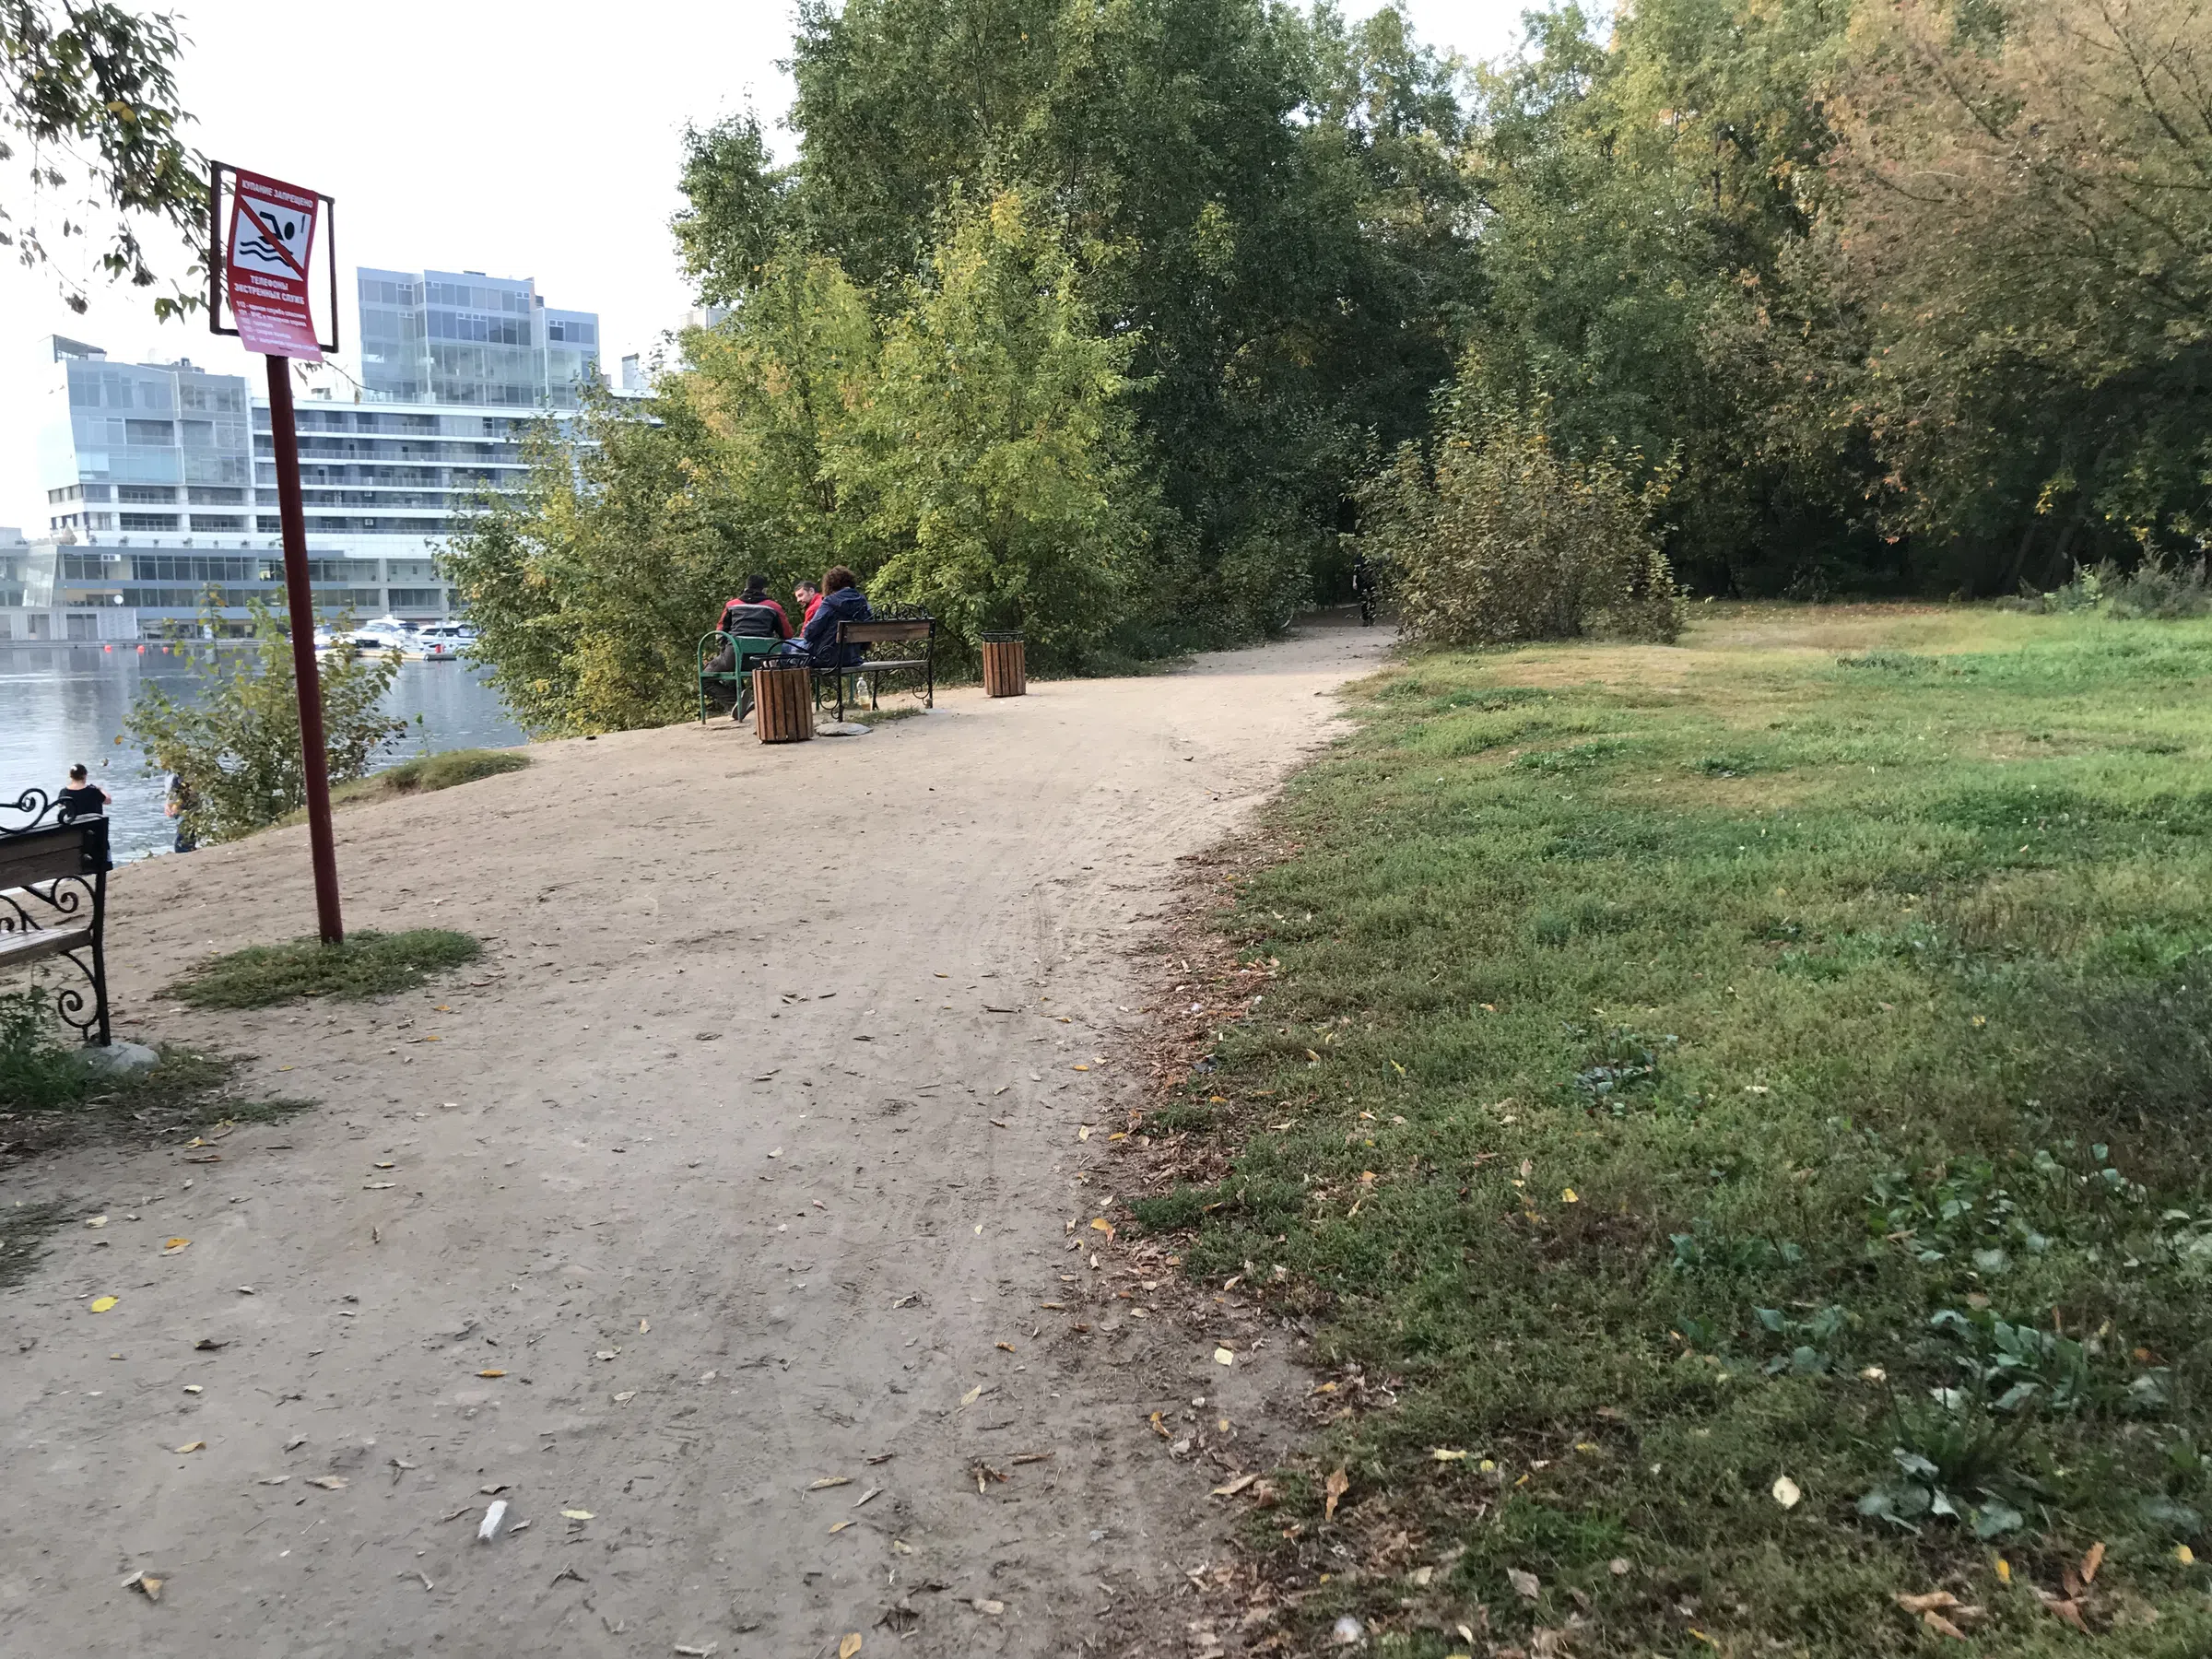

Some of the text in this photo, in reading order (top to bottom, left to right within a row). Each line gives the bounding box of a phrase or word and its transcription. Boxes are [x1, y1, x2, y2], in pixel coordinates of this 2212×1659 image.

[241, 179, 313, 208] КУПАНИЕ ЗАПРЕЩЕНО
[234, 282, 305, 305] ЭКСТРЕННЫХ СЛУЖБ
[250, 275, 288, 290] ТЕЛЕФОНЫ
